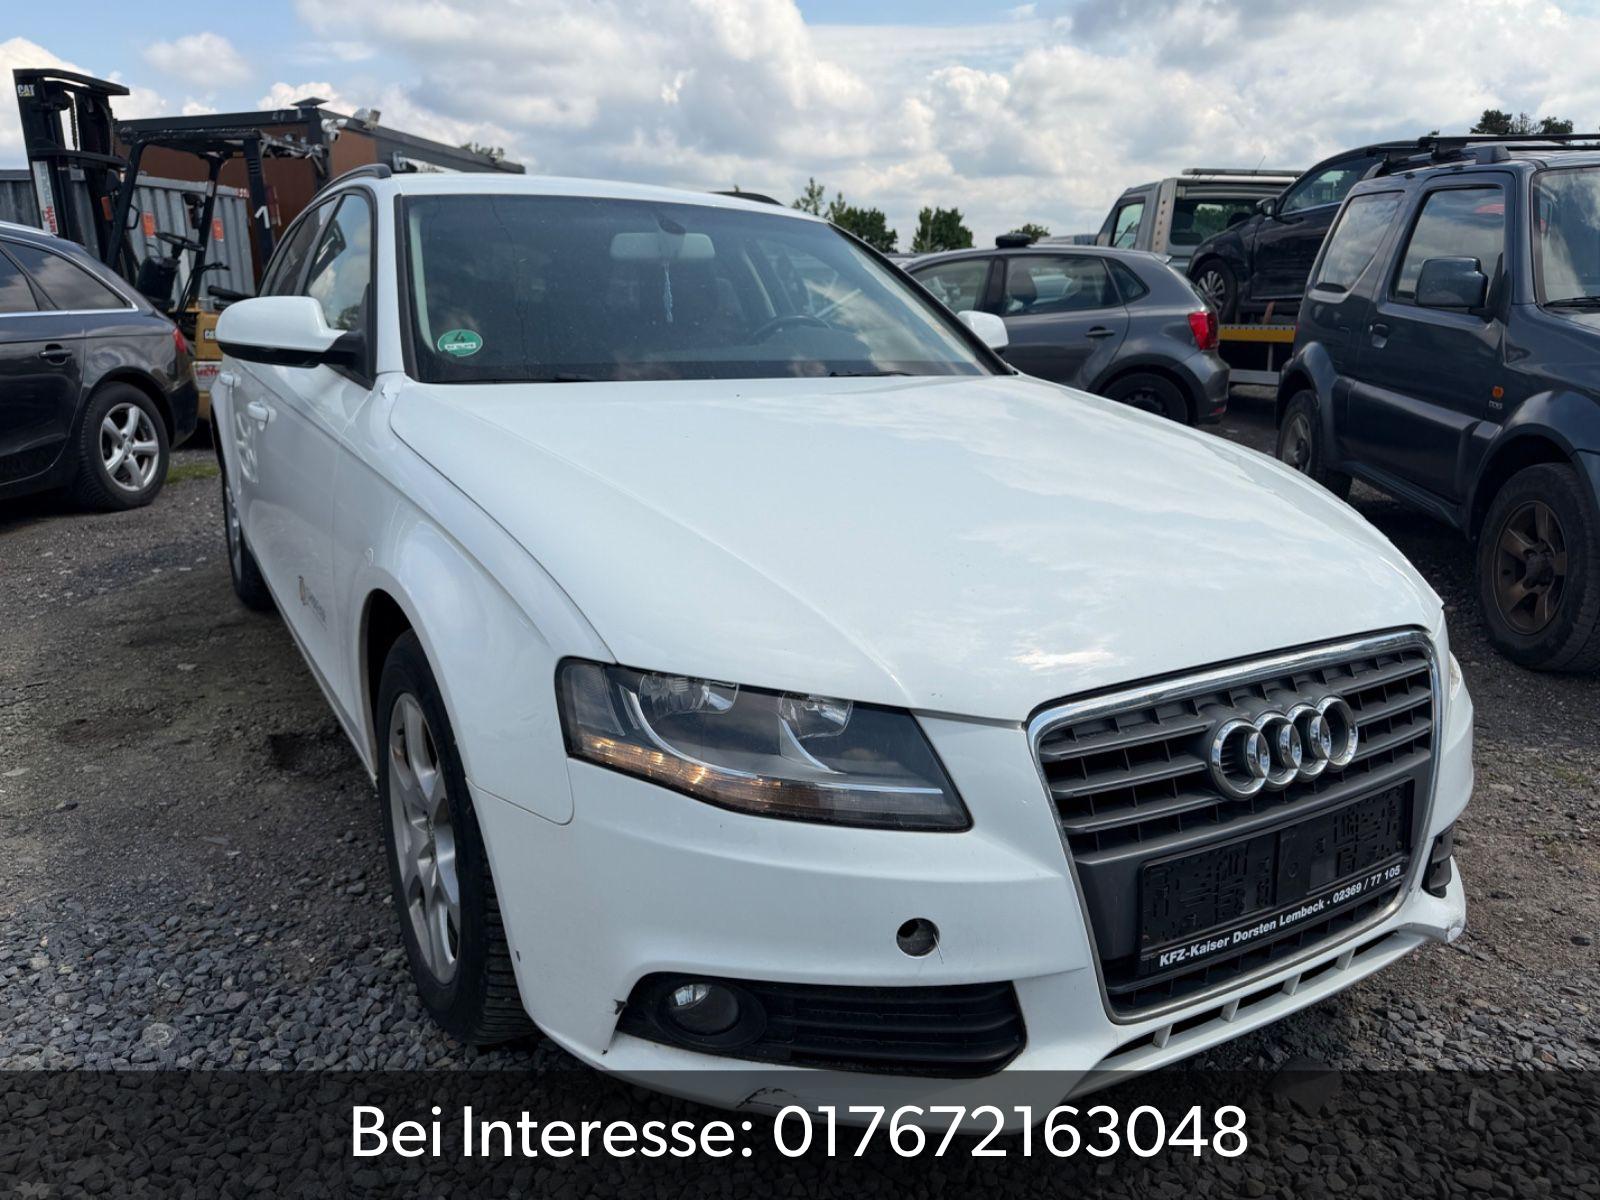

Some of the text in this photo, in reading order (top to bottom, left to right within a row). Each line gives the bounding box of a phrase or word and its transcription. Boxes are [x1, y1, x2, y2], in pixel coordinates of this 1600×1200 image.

[17, 84, 35, 97] CAT
[254, 206, 271, 229] 1
[453, 331, 466, 343] 4
[1159, 937, 1230, 967] KFZ-Kaiser
[1232, 920, 1277, 943] Dorsten
[1279, 899, 1325, 927] Lembeck
[1332, 882, 1362, 904] 02369
[1370, 872, 1383, 887] 77
[1384, 864, 1401, 880] 105
